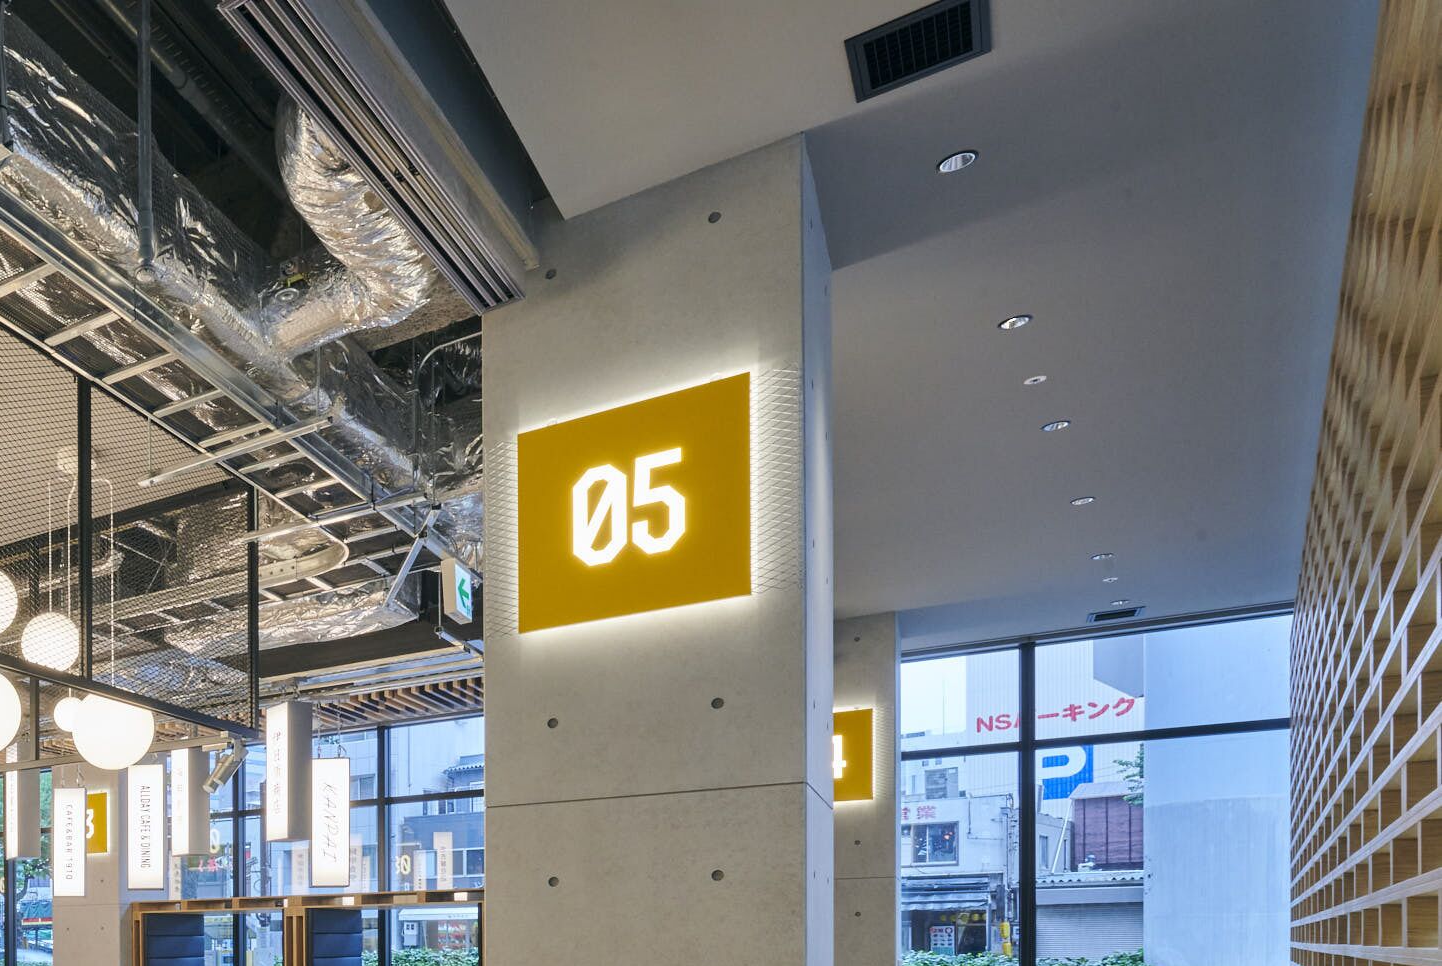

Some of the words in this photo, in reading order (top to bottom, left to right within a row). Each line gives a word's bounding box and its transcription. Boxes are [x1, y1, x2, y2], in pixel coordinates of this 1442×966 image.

[572, 446, 687, 567] 05
[976, 697, 1136, 733] NSーキング
[140, 785, 151, 813] ALLDAY
[140, 815, 151, 833] CAFE
[322, 782, 338, 863] KANPAI
[140, 843, 151, 869] DINING
